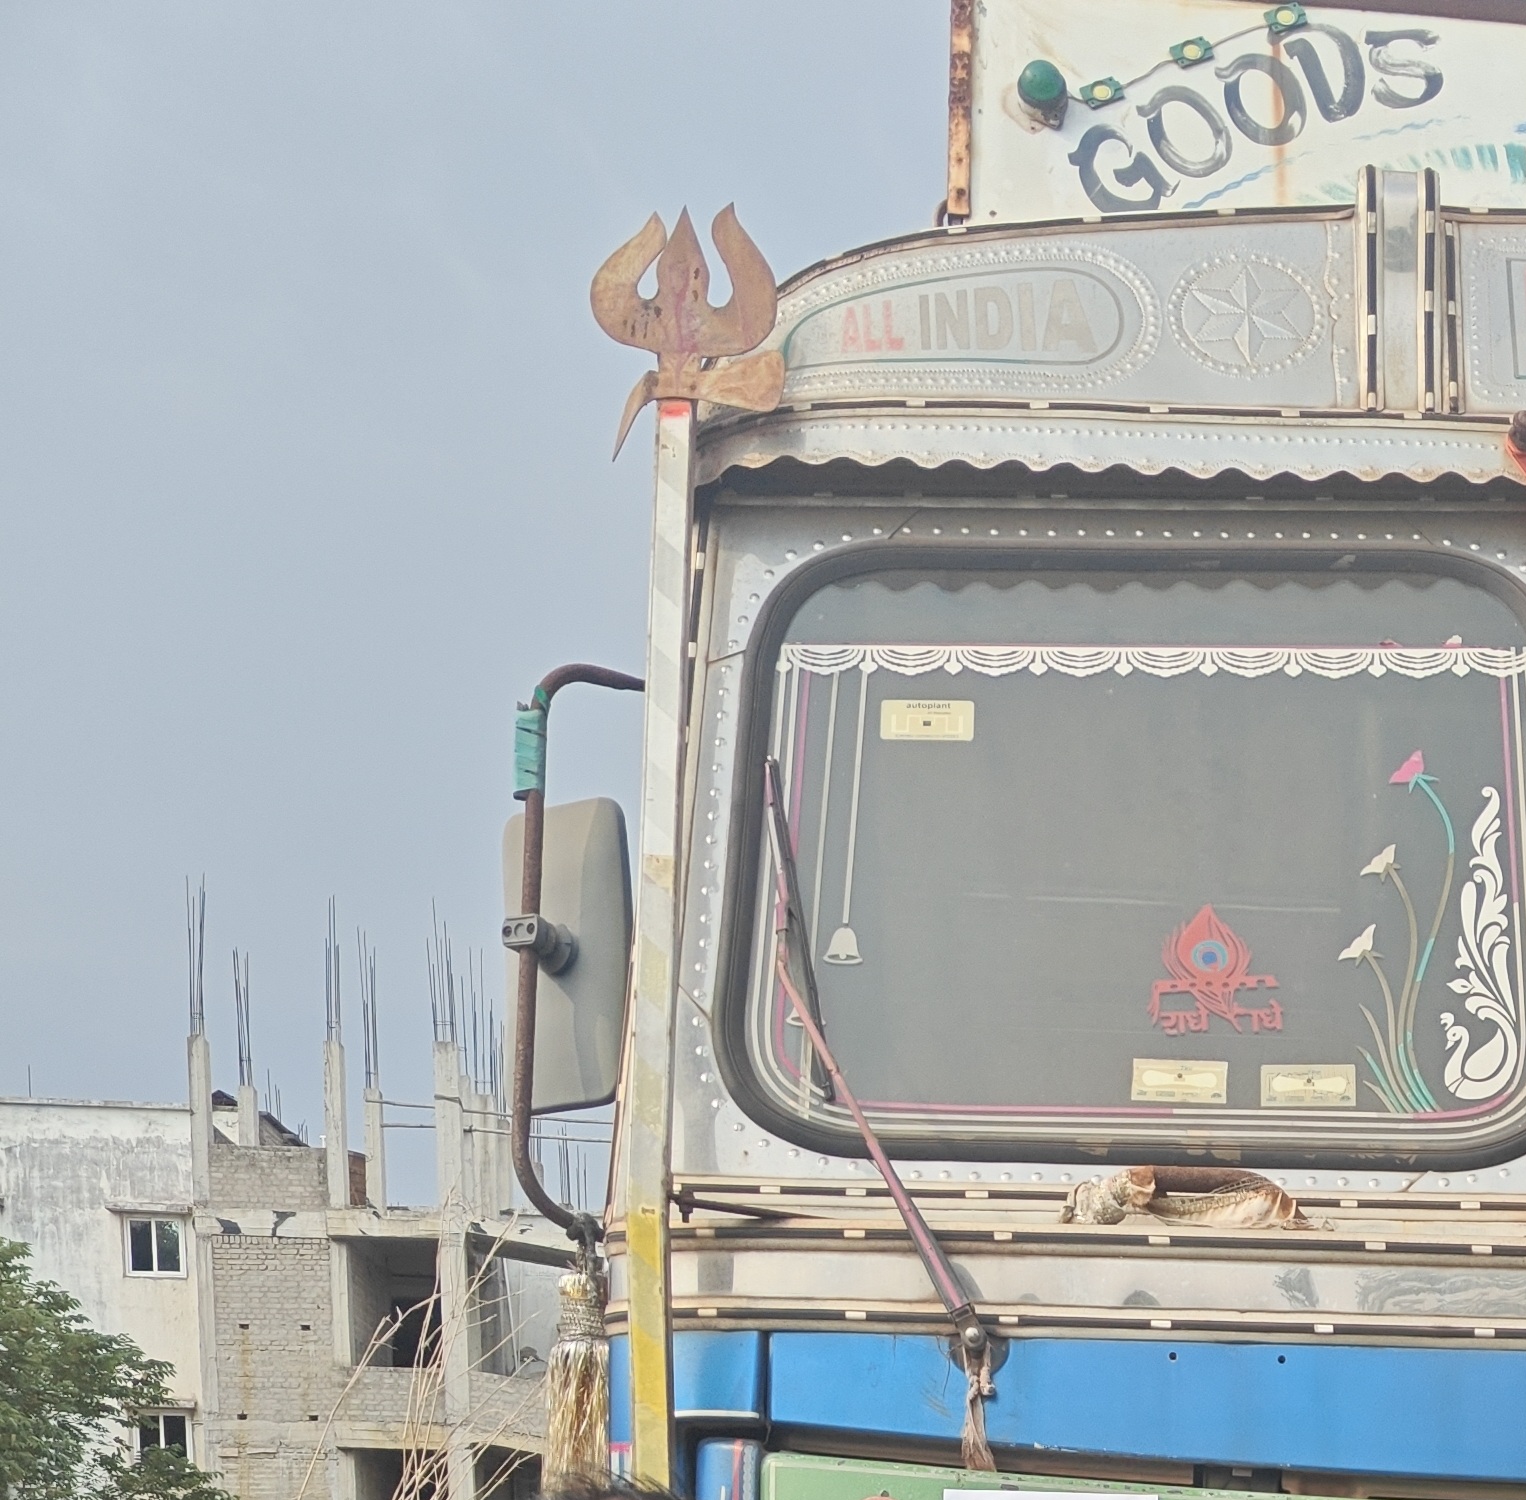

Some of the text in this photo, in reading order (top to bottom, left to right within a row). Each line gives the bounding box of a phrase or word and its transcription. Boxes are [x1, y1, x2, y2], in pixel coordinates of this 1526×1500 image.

[1067, 28, 1444, 212] GOODS
[841, 278, 1098, 353] ALL INDIA
